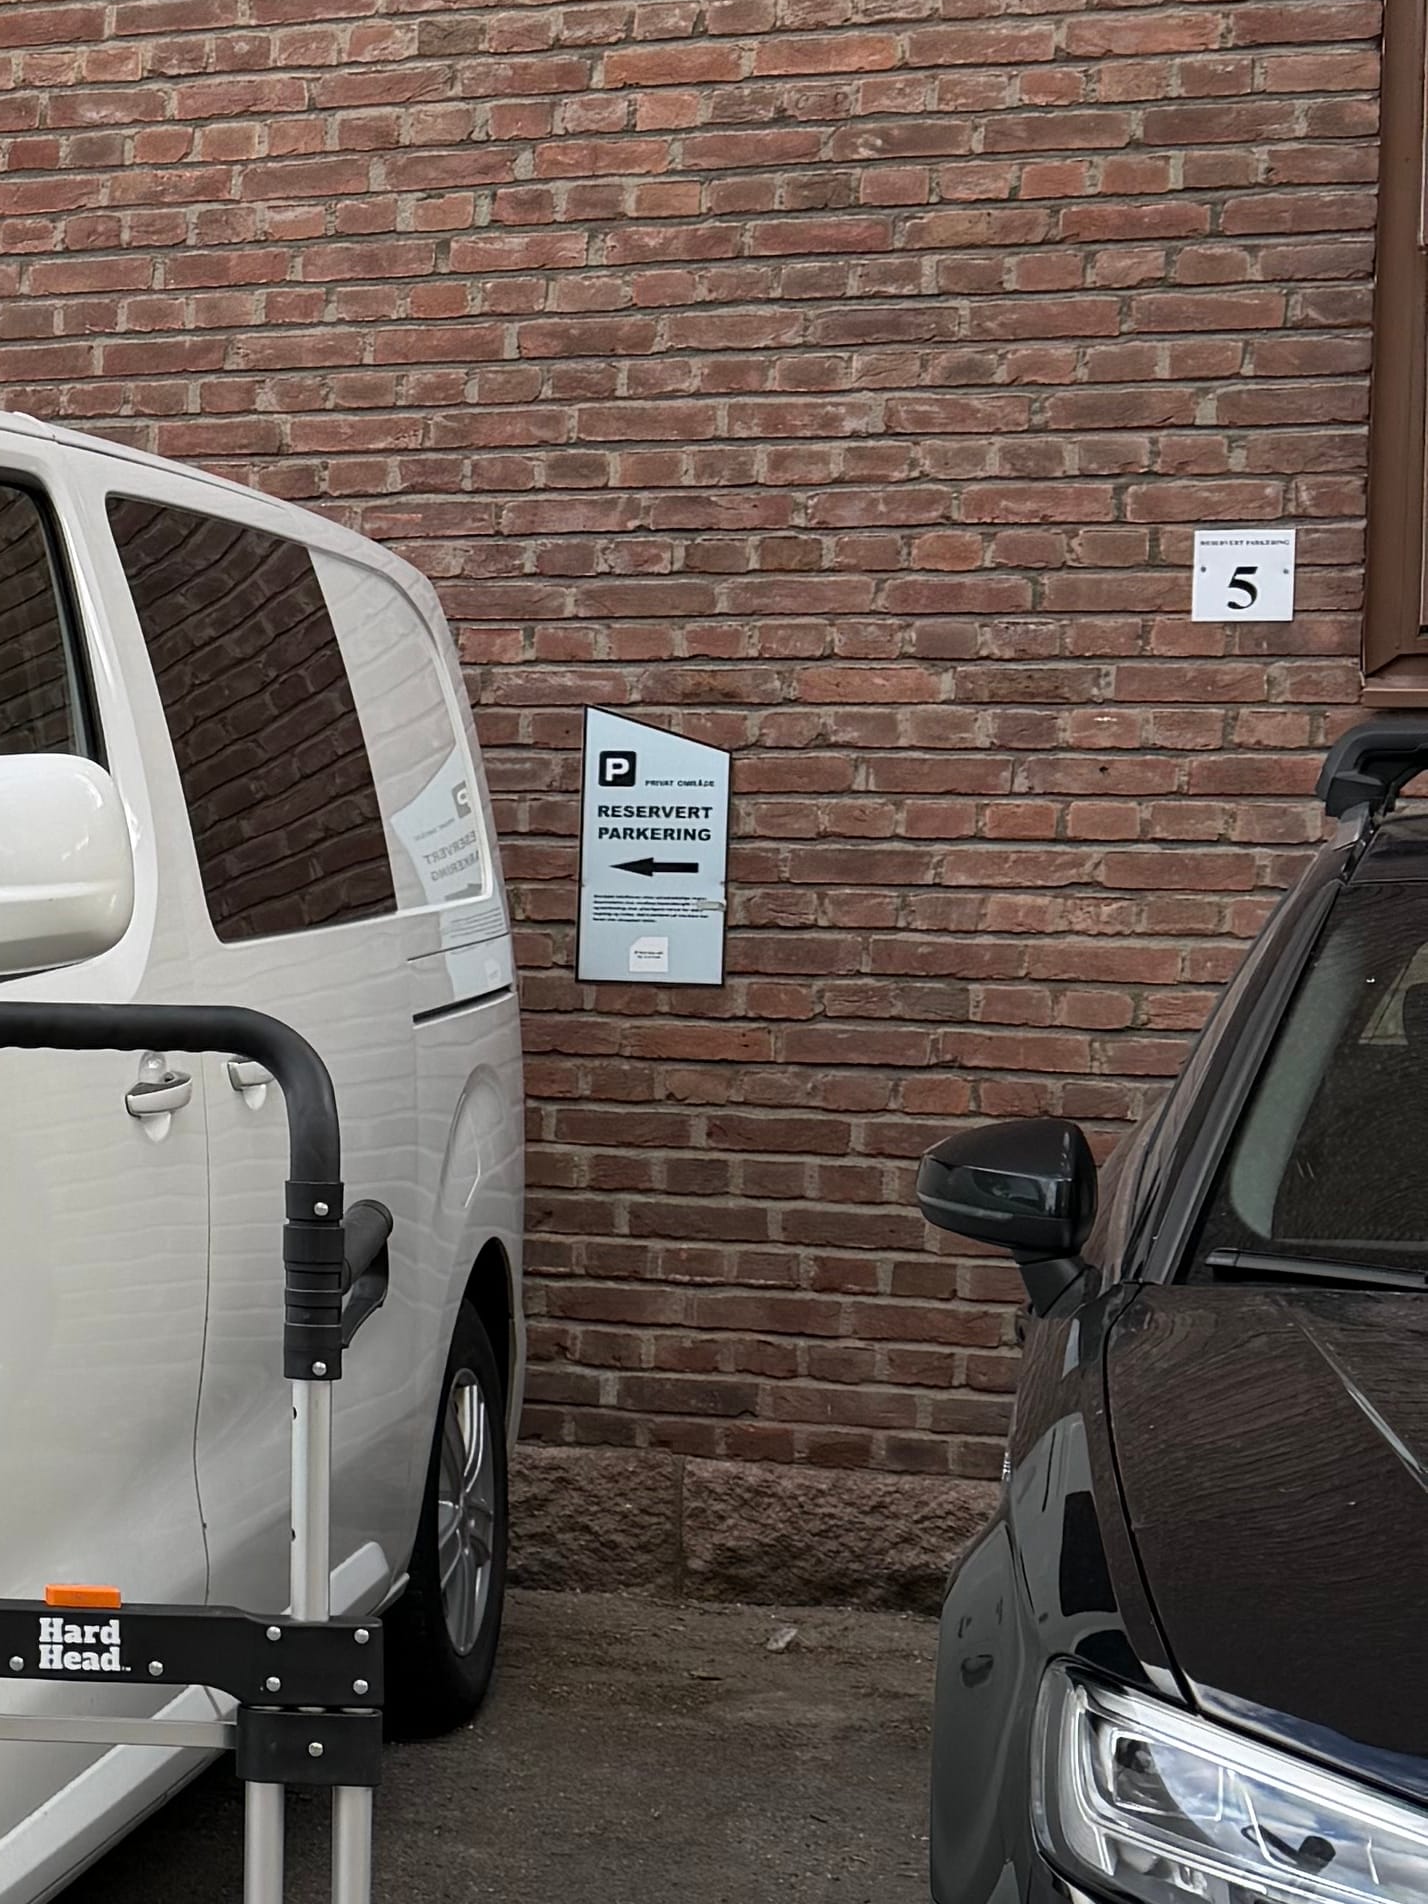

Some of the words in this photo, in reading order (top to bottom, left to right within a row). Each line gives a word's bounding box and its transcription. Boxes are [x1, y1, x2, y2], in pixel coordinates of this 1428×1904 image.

[1227, 566, 1258, 610] 5
[605, 757, 630, 782] P
[597, 805, 714, 819] RESERVERT
[598, 827, 712, 841] PARKERING
[39, 1618, 121, 1645] Hard
[39, 1645, 121, 1672] Head
